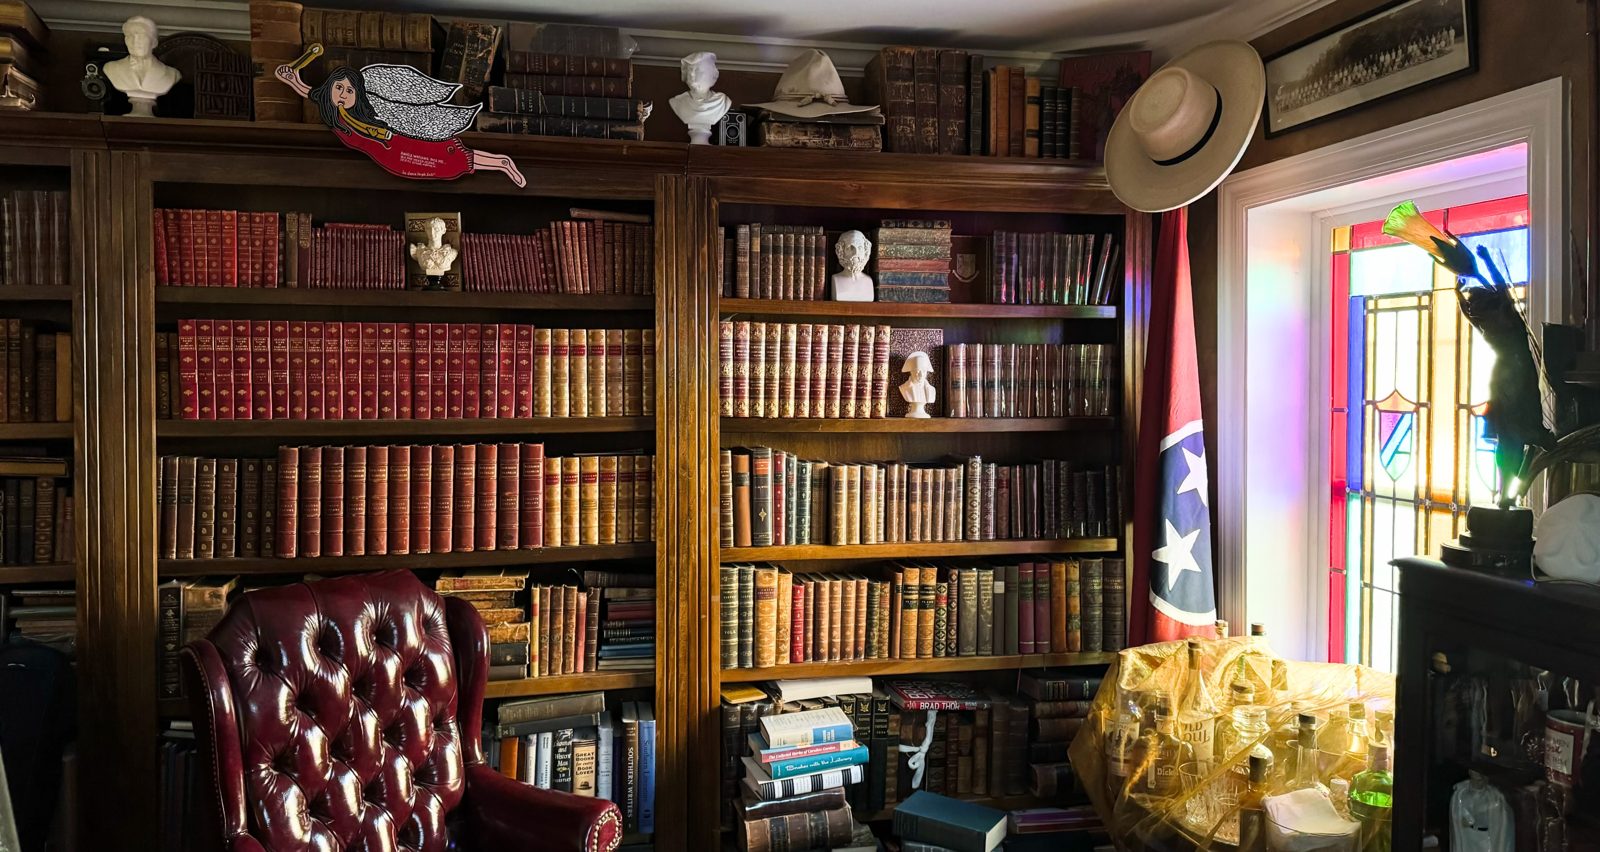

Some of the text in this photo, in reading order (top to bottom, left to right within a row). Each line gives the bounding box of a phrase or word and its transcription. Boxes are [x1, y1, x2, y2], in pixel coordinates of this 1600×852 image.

[920, 701, 960, 710] BRAD THOR
[1184, 730, 1210, 744] OUL
